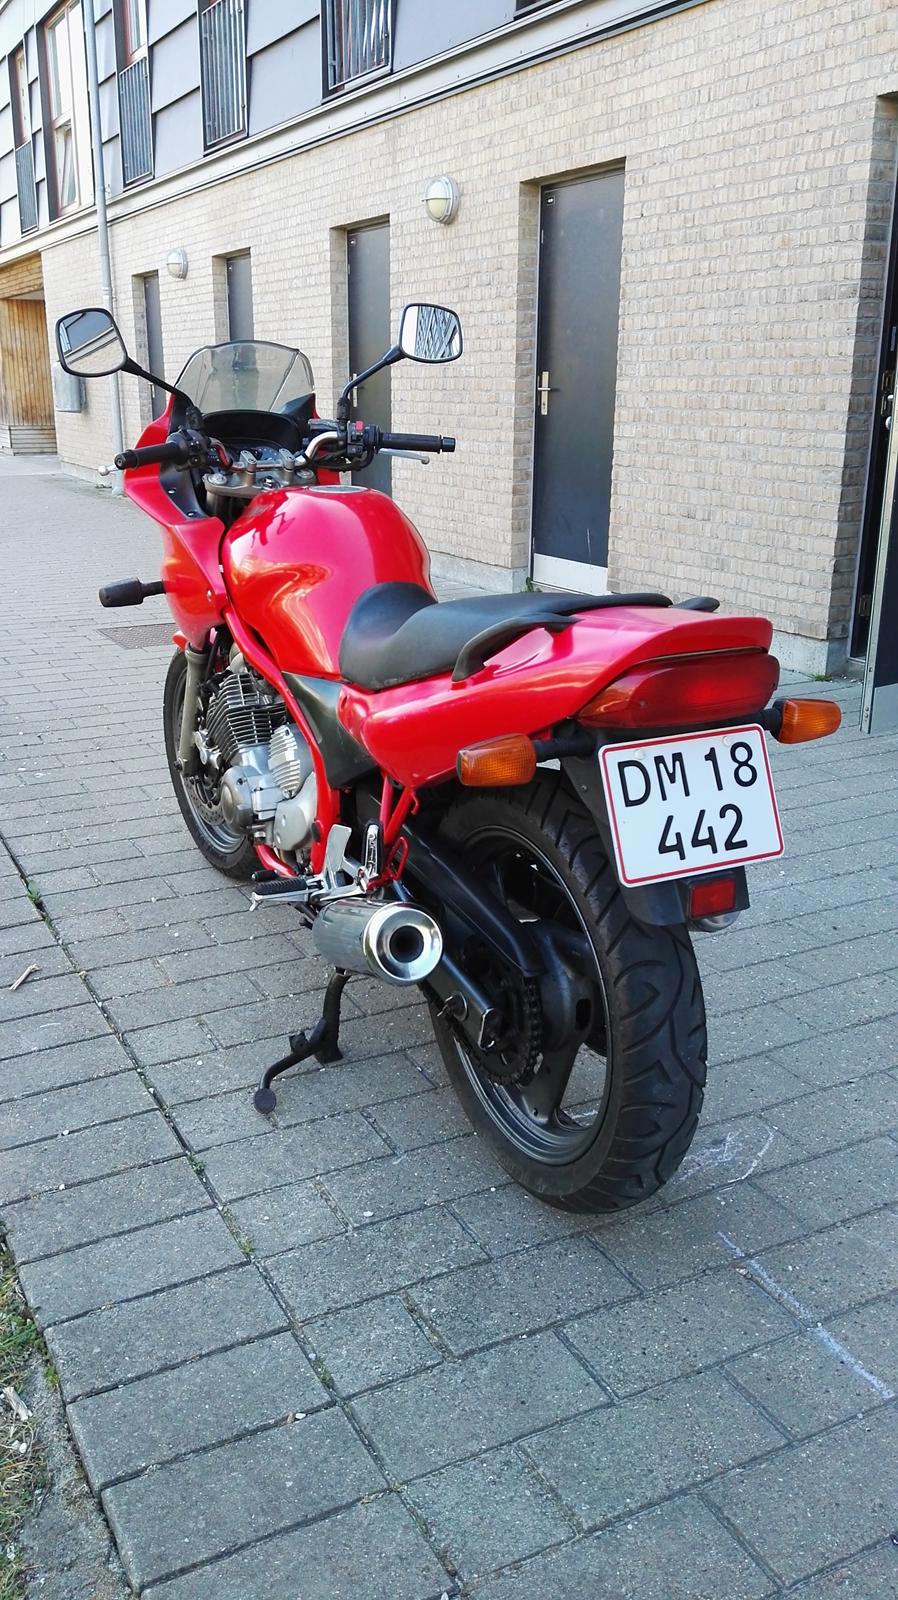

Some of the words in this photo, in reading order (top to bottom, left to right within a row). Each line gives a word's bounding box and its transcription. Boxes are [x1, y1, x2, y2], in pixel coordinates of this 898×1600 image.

[617, 752, 690, 807] DM
[704, 741, 757, 791] 18
[658, 803, 748, 860] 442
